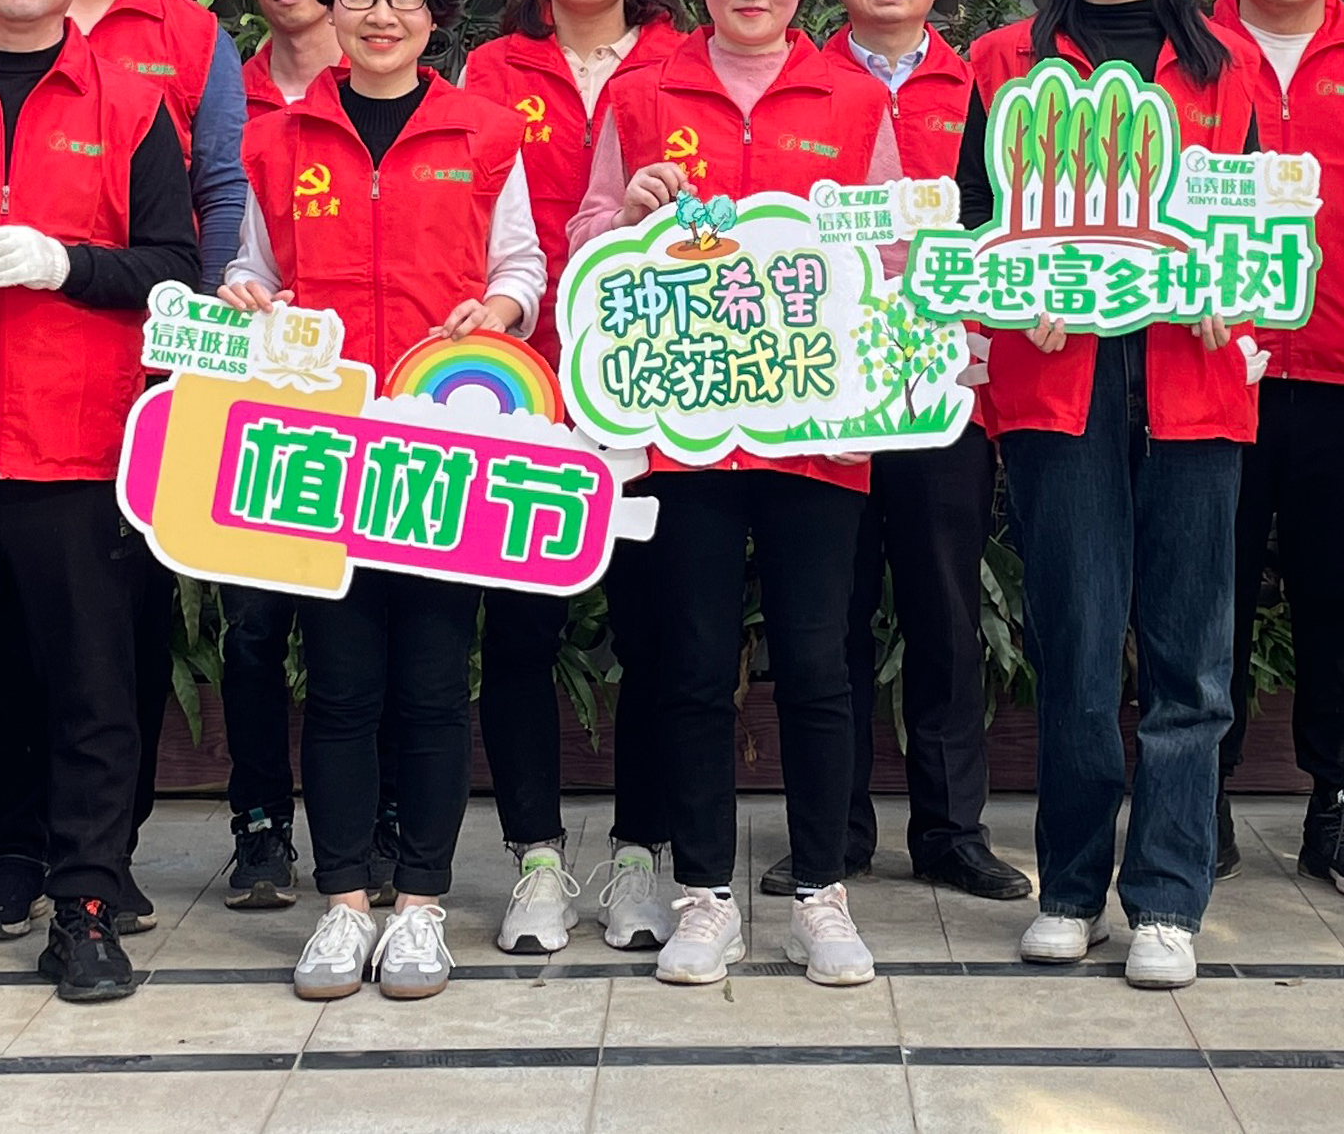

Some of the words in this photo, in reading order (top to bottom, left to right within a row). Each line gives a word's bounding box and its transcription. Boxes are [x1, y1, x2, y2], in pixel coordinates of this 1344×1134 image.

[1208, 158, 1256, 174] XYG
[1277, 161, 1303, 182] 35
[838, 189, 889, 206] XYG
[913, 184, 942, 209] 35
[1187, 195, 1218, 206] XINYI
[1221, 197, 1256, 208] GLASS
[819, 232, 852, 244] XINYI
[856, 229, 894, 241] GLASS
[920, 233, 1305, 319] 要想富多种树
[600, 253, 827, 338] 种下希望
[184, 300, 254, 328] XYG
[283, 313, 321, 346] 35
[149, 347, 192, 368] XINYI
[196, 355, 248, 374] GLASS
[603, 330, 837, 411] 收获成长
[235, 421, 598, 561] 植树节
